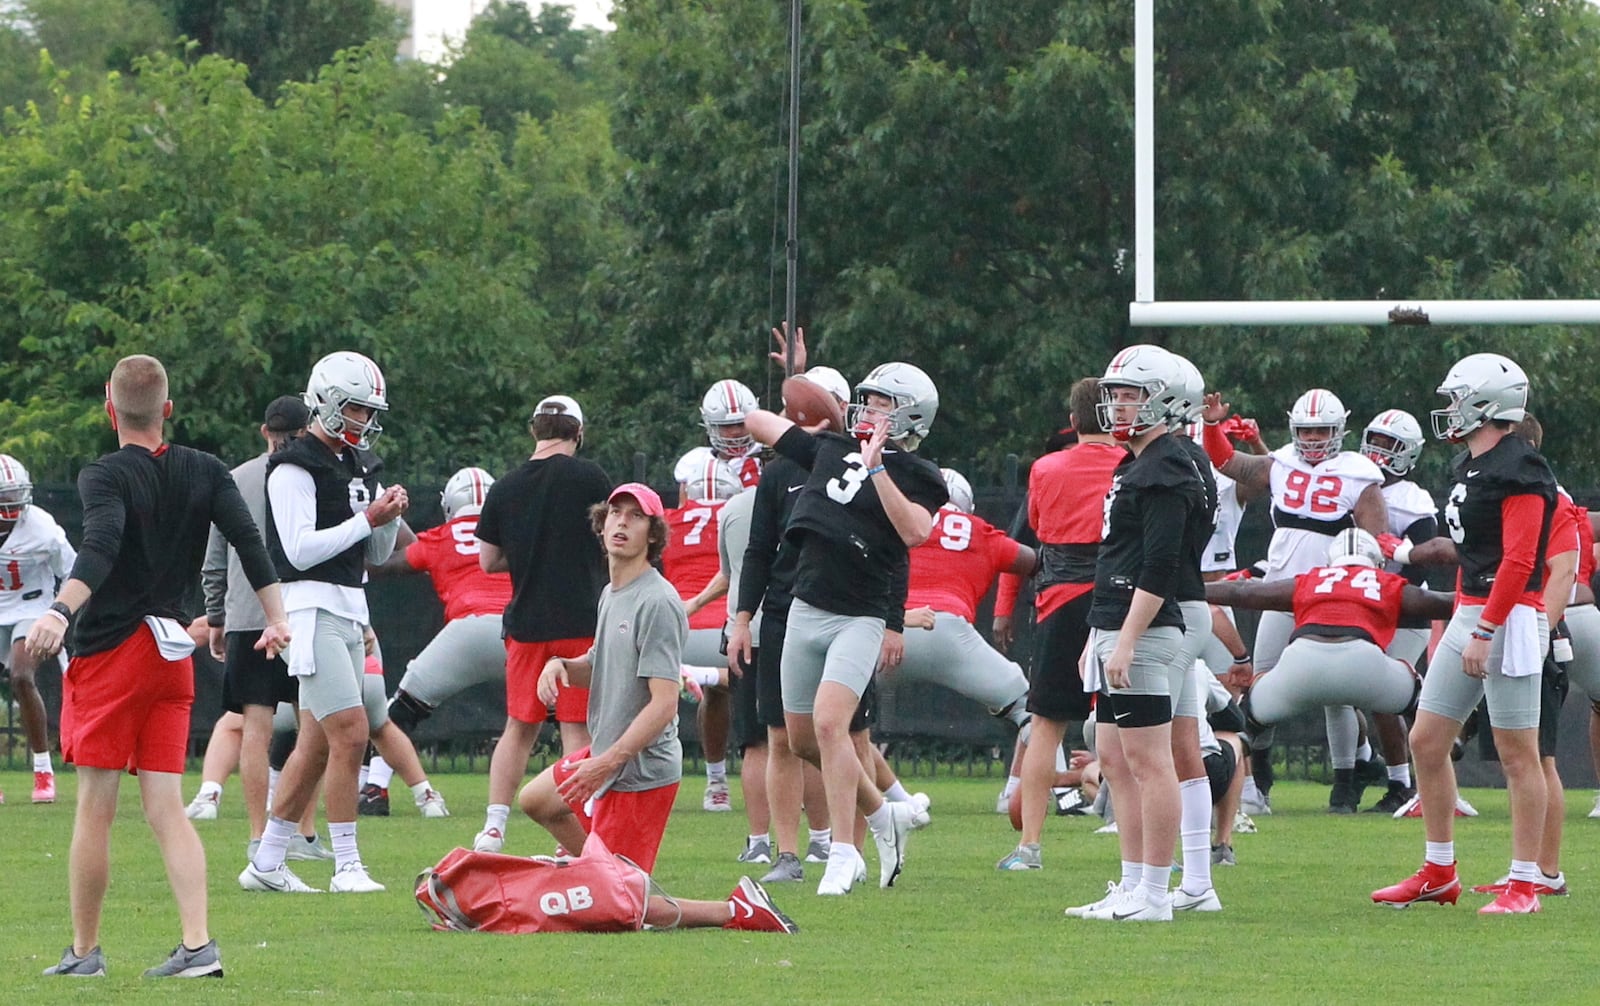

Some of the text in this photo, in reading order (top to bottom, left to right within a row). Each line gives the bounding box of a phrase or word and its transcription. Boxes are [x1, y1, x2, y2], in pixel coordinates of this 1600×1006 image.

[826, 452, 869, 505] 3
[1283, 468, 1343, 513] 92
[932, 511, 972, 551] 9
[0, 560, 24, 590] 1
[1314, 567, 1381, 601] 74
[540, 885, 594, 916] QB
